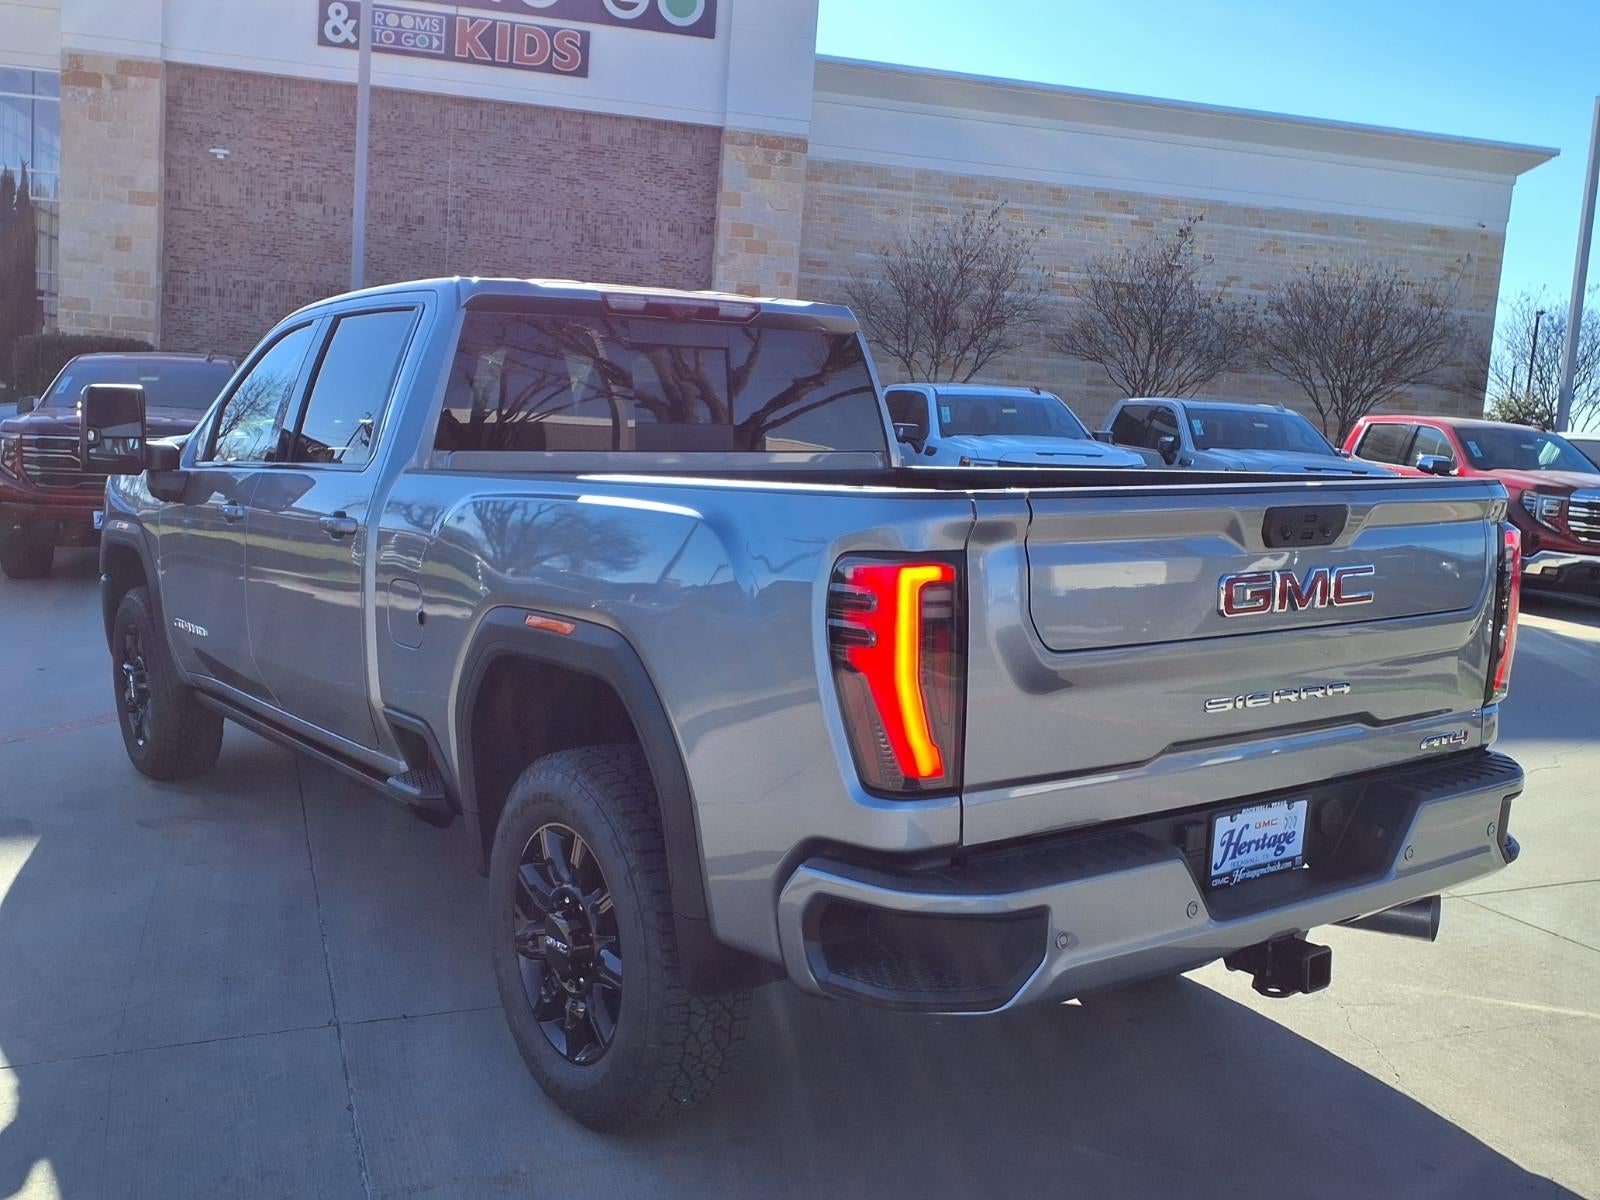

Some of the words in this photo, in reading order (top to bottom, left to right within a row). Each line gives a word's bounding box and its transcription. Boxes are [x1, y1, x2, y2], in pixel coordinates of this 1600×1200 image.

[324, 2, 357, 43] &
[374, 12, 440, 32] ROOMS
[374, 29, 395, 44] TO
[401, 33, 429, 48] GO
[455, 16, 581, 72] KIDS
[1218, 564, 1375, 617] GMC
[1204, 682, 1351, 713] SIERRA
[1420, 730, 1469, 750] AT4
[1254, 818, 1278, 830] GMC
[1213, 823, 1297, 871] Heritage
[1211, 876, 1230, 887] GMC
